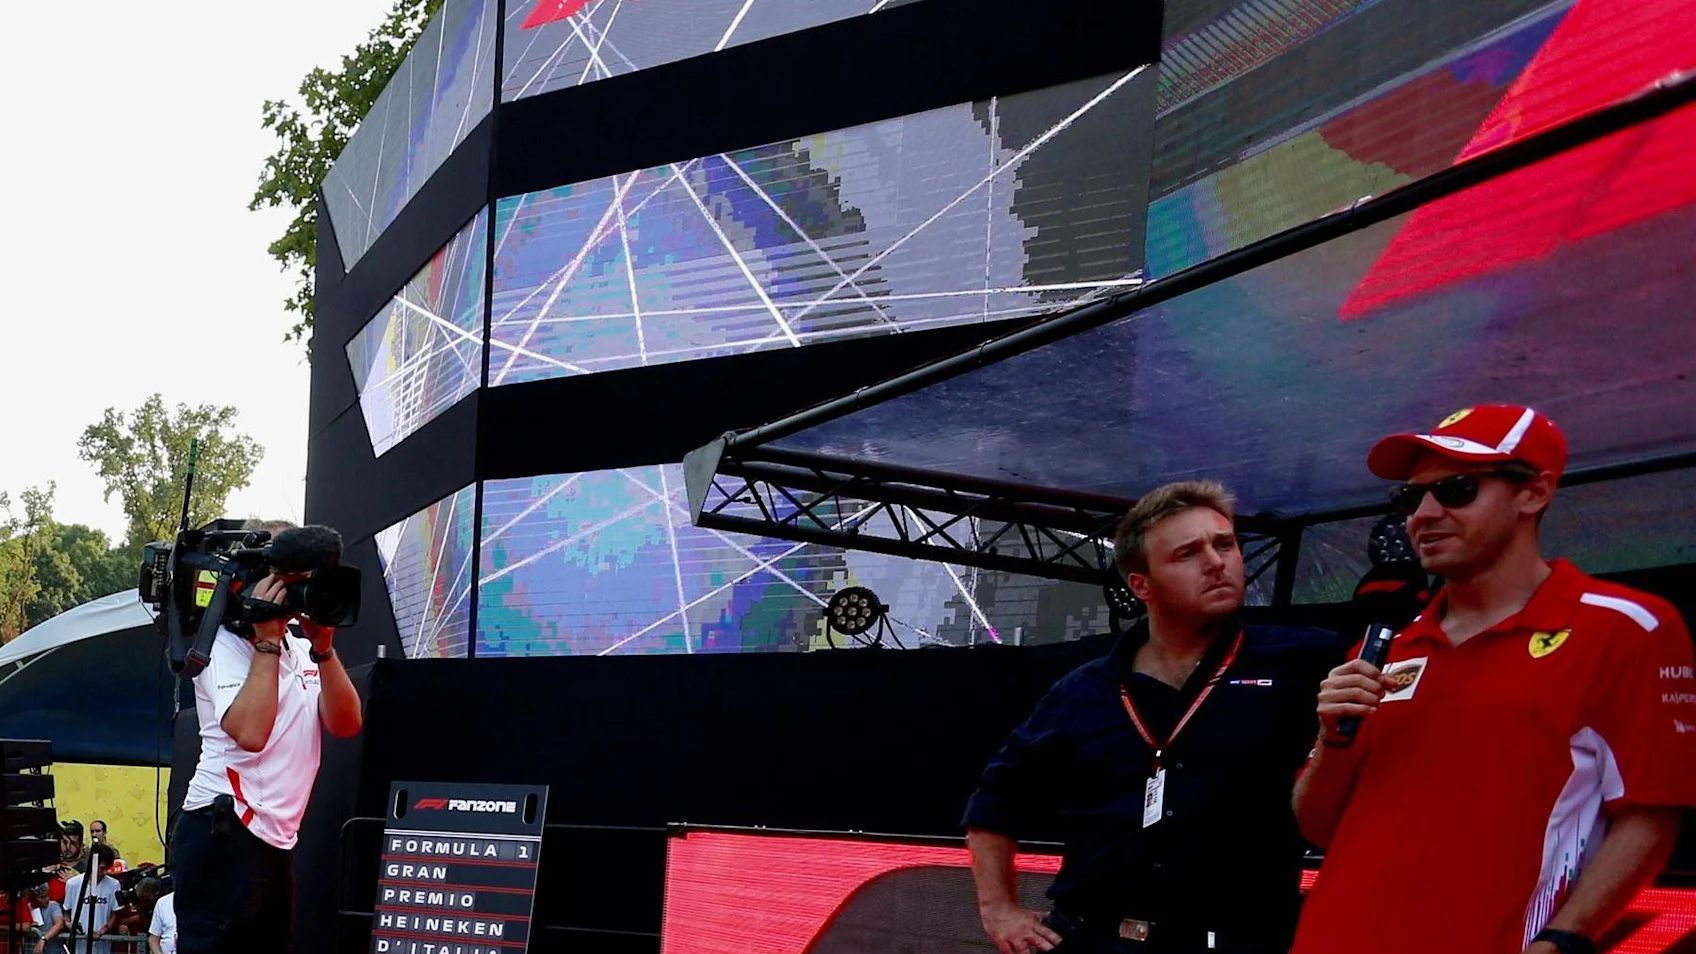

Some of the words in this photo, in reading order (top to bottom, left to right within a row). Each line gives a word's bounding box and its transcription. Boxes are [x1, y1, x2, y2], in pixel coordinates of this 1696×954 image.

[391, 838, 498, 857] FORMULA
[518, 846, 529, 859] 1
[387, 864, 447, 879] GRAN
[384, 888, 474, 908] PREMIO
[380, 914, 504, 937] HEINEKEN
